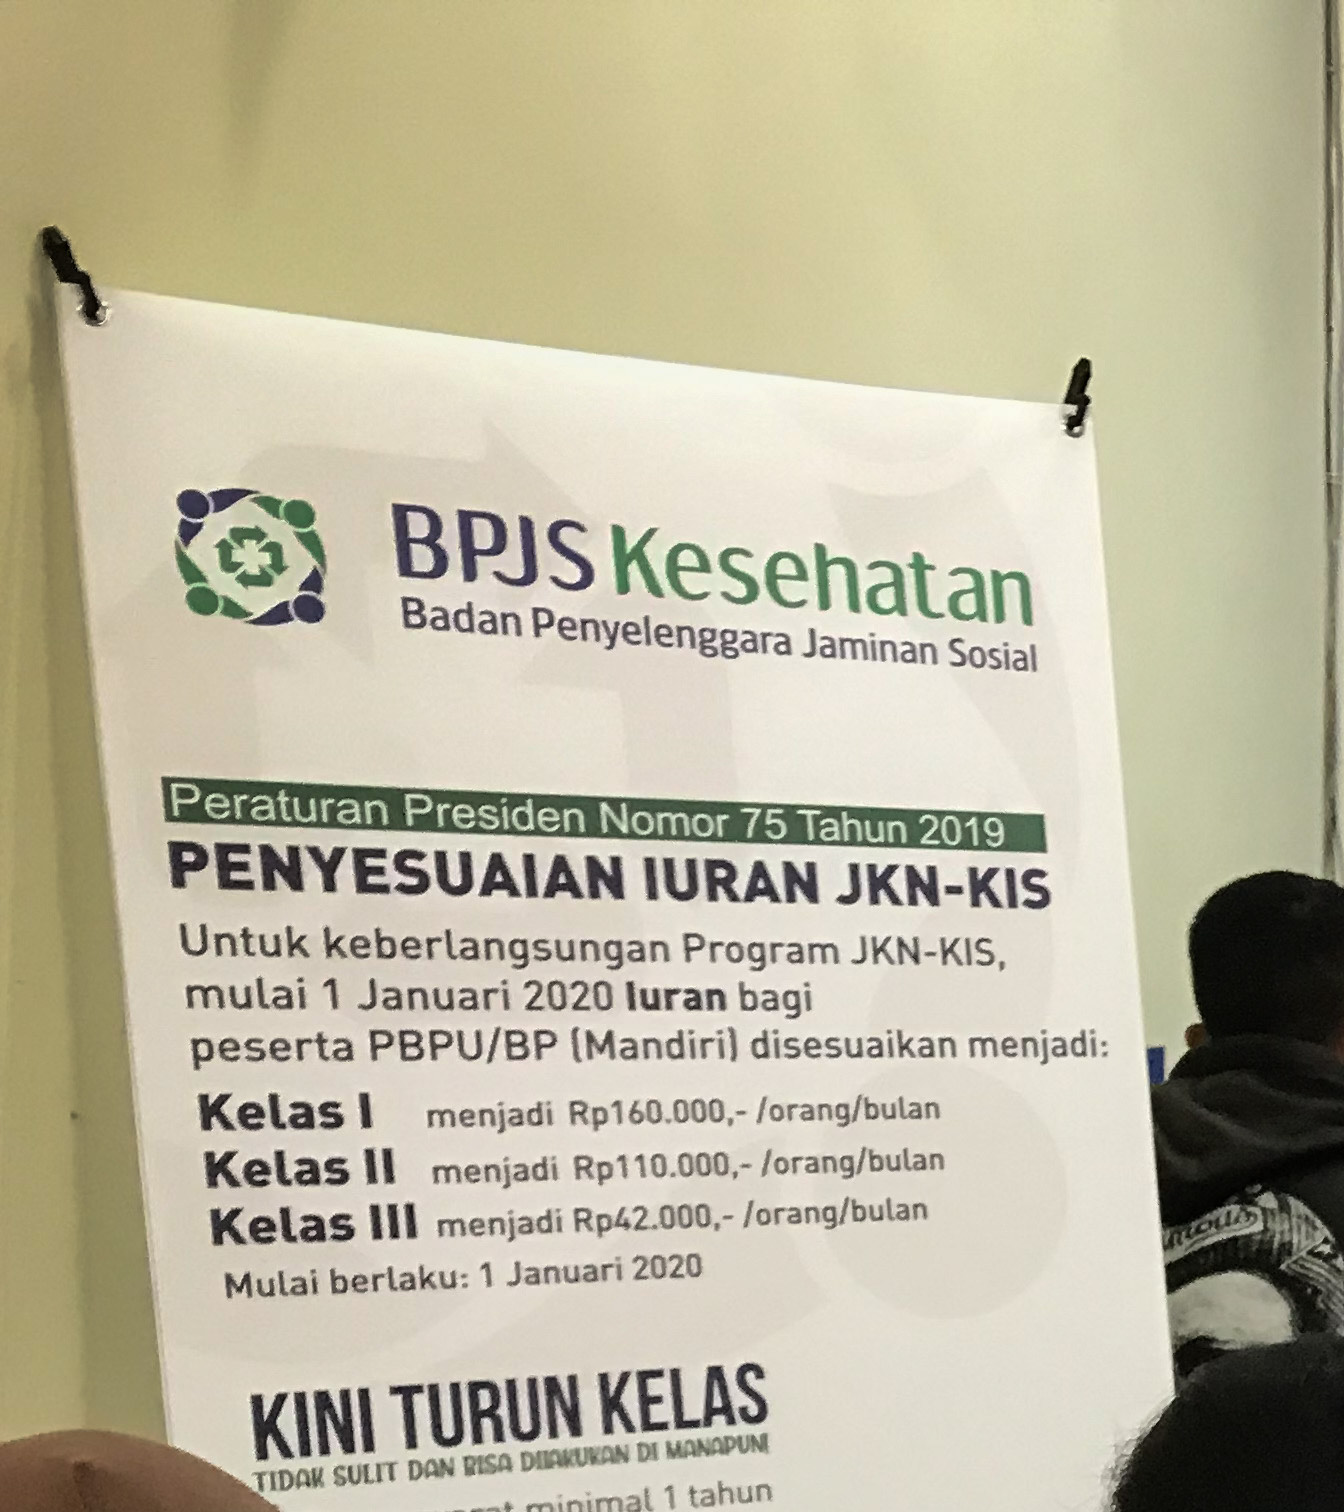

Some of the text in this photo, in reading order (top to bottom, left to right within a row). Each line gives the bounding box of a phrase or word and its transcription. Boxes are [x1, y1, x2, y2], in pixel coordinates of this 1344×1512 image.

[391, 502, 1034, 627] BPJS Kesehatan
[400, 596, 1038, 673] Badan Penyelenggara Jaminan Sosial
[170, 783, 1005, 848] Peraturan Presiden Nomor 75 Tahun 2019
[167, 840, 1051, 910] PENYESUAIAN IURAN JKN-KIS
[179, 923, 1006, 972] Untuk keberlangsungan Program JKN-KIS,
[185, 976, 812, 1020] mulai 1 Januari 2020 Iuran bagi
[190, 1026, 1108, 1071] peserta PBPU/BP (Mandiri) disesuaikan menjadi:
[198, 1092, 941, 1135] Kelas I menjadi Rp160.000,- /orang/bulan
[204, 1146, 945, 1190] Kelas II menjadi Rp110.000,- /orang/bulan
[210, 1196, 929, 1246] Kelas III menjadi Rp42.000,- /orang/bulan
[224, 1252, 703, 1299] Mulai berlaku: 1 Januari 2020
[250, 1362, 769, 1461] KINI TURUN KELAS
[254, 1467, 325, 1493] TIDAK
[332, 1461, 397, 1487] SULIT
[407, 1458, 455, 1481] DAN
[636, 1441, 658, 1463] DI
[664, 1484, 676, 1510] 1
[688, 1480, 773, 1509] tahun
